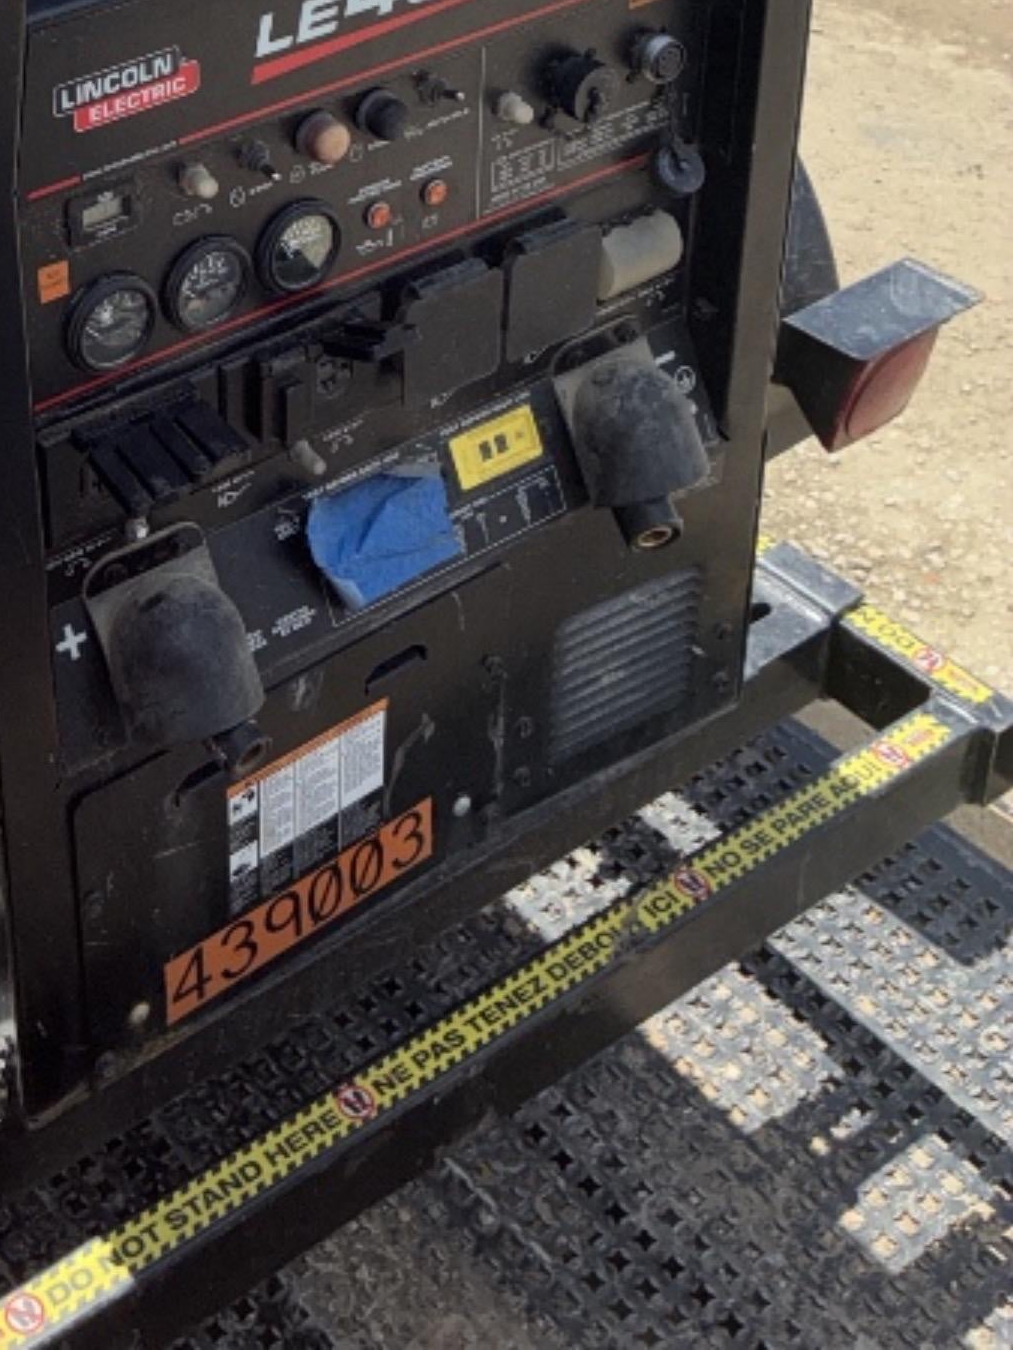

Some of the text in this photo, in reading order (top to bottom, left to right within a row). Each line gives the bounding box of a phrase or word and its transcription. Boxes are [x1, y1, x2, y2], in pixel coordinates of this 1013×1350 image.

[59, 51, 174, 111] LINCOLN
[88, 74, 187, 122] ELECTRIC
[703, 853, 743, 879] NO
[740, 832, 772, 859] SE
[770, 795, 828, 833] PARE
[172, 811, 424, 1004] 439003
[371, 1066, 414, 1096] NE
[412, 1029, 467, 1073] PAS
[462, 979, 548, 1035] TENEZ
[643, 889, 680, 922] ICI
[43, 1111, 340, 1309] DO NOT STAND HERE
